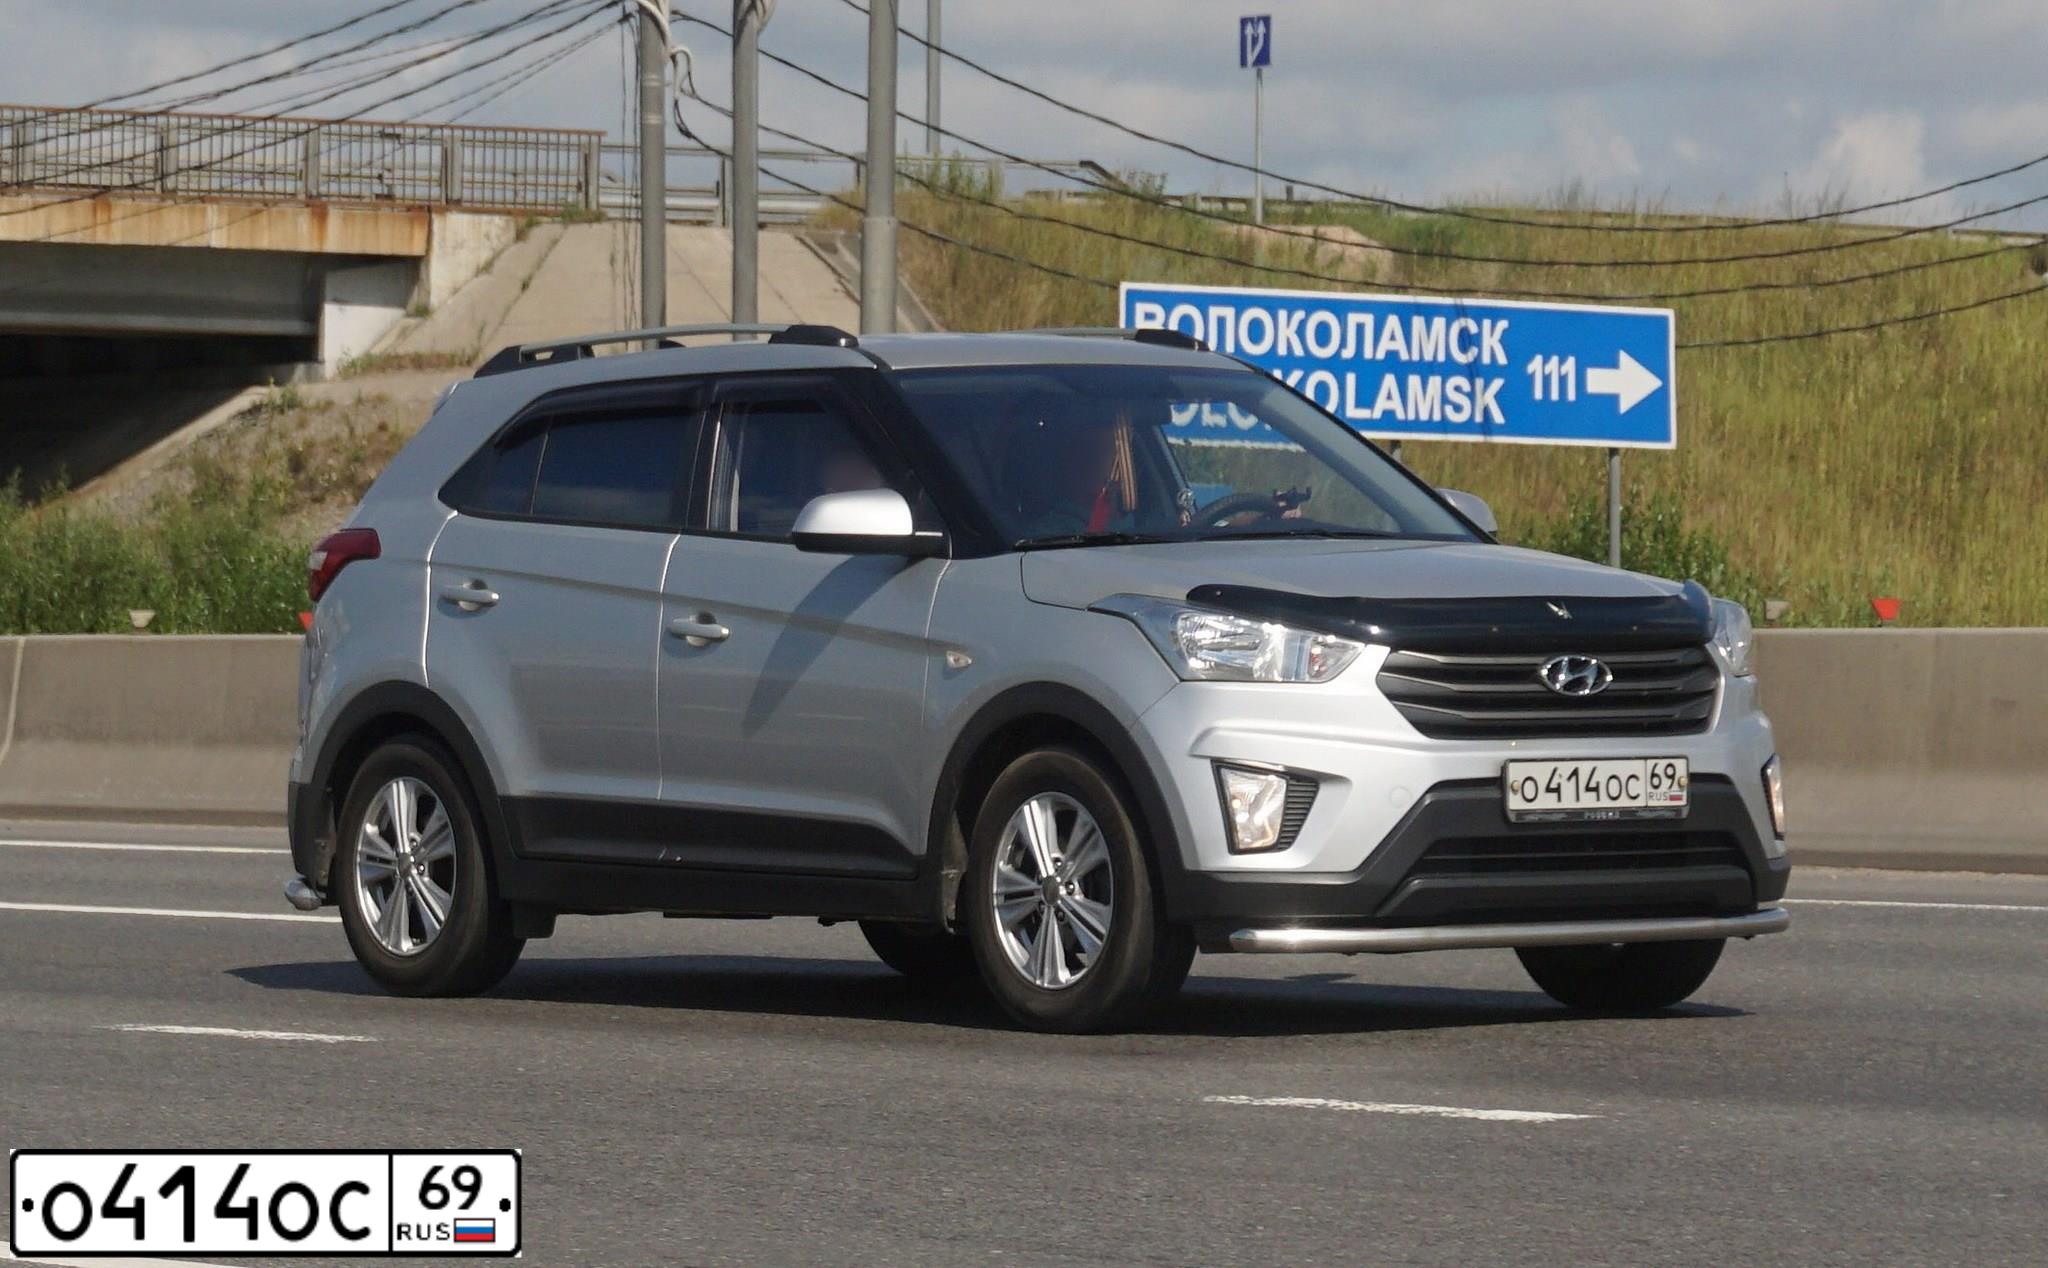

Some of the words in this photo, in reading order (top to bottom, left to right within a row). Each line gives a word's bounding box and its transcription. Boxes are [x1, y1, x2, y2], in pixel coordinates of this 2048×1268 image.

[1135, 303, 1509, 364] ВОЛОКОЛАМСК
[1527, 354, 1576, 401] 111
[1650, 763, 1676, 790] 69
[1649, 792, 1668, 801] RUS
